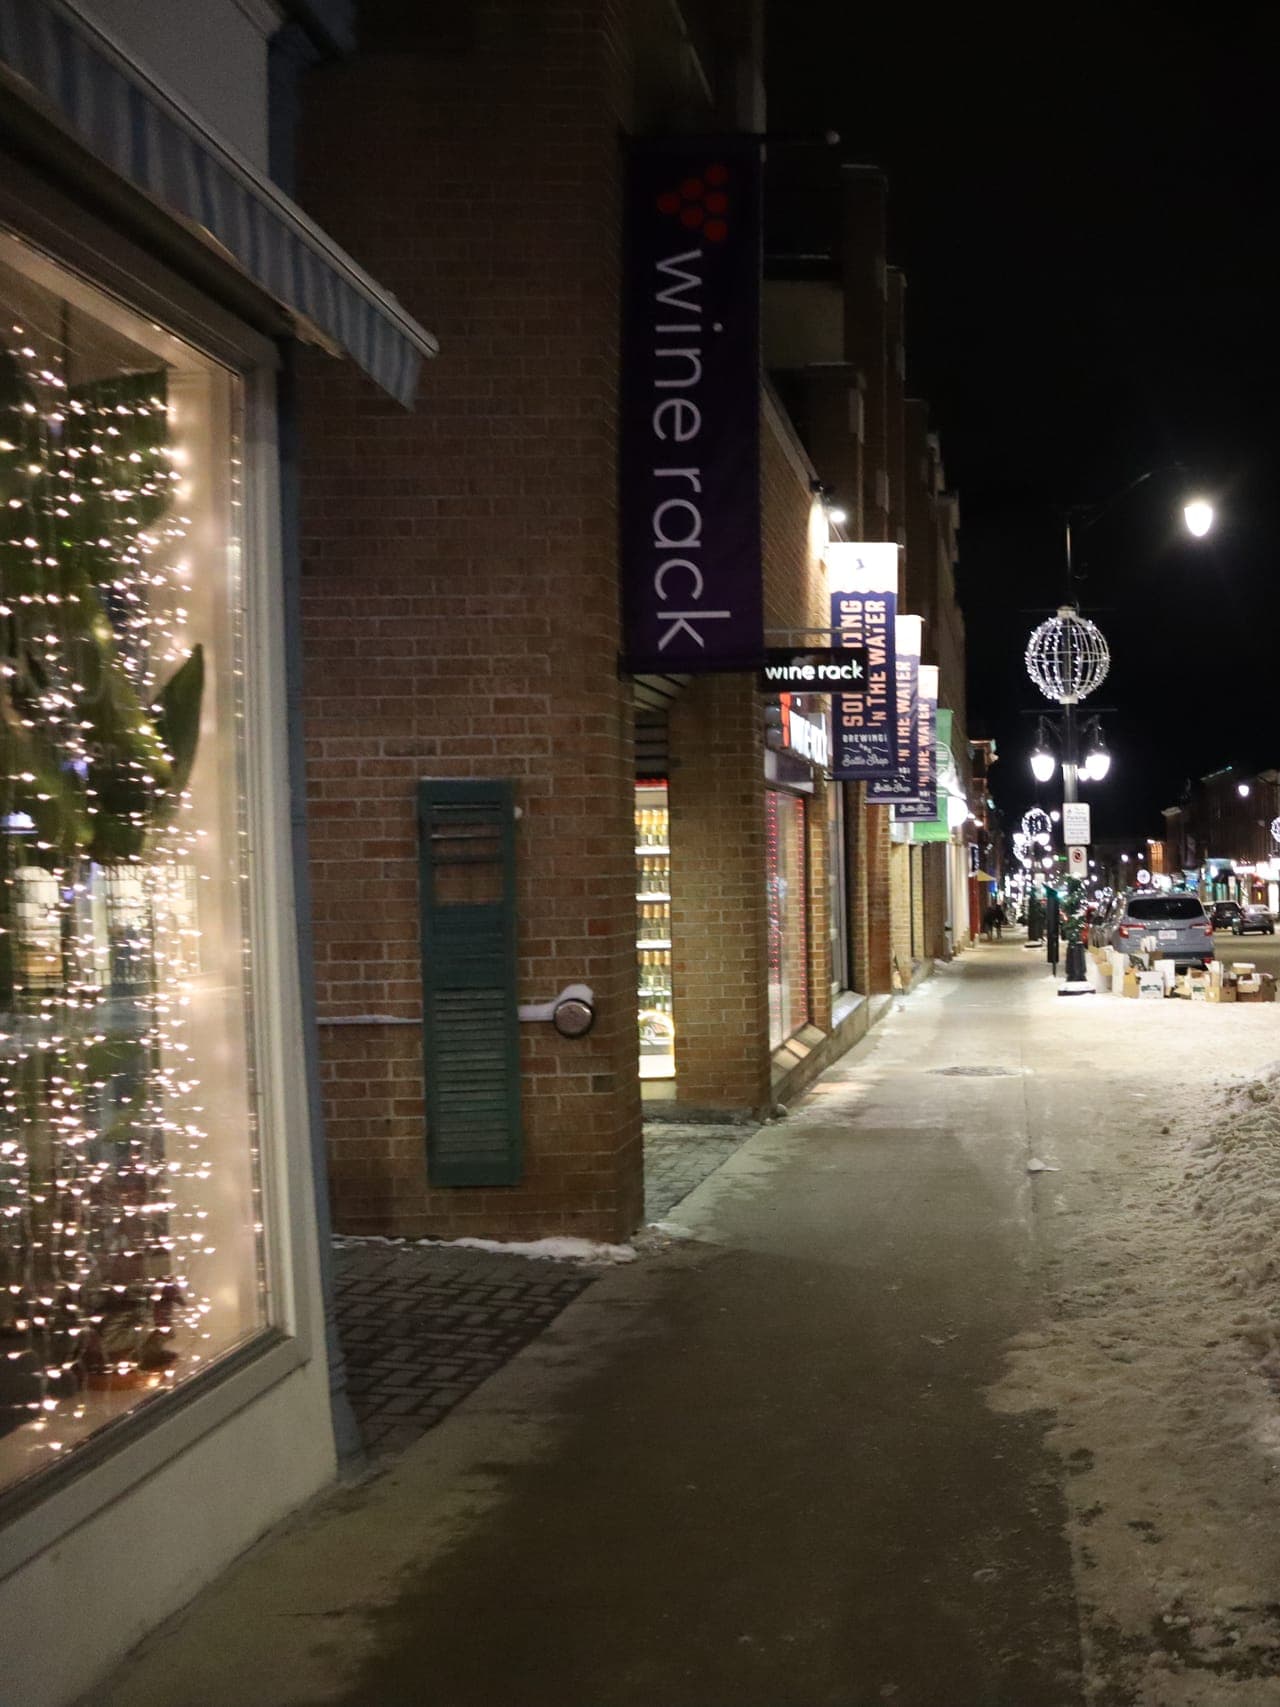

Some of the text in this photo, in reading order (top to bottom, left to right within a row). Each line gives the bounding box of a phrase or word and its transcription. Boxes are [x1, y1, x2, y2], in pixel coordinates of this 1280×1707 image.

[652, 248, 731, 651] wine rack
[840, 599, 864, 727] SOING
[864, 600, 886, 666] WATER
[764, 658, 865, 681] wine rack
[865, 671, 886, 706] THE
